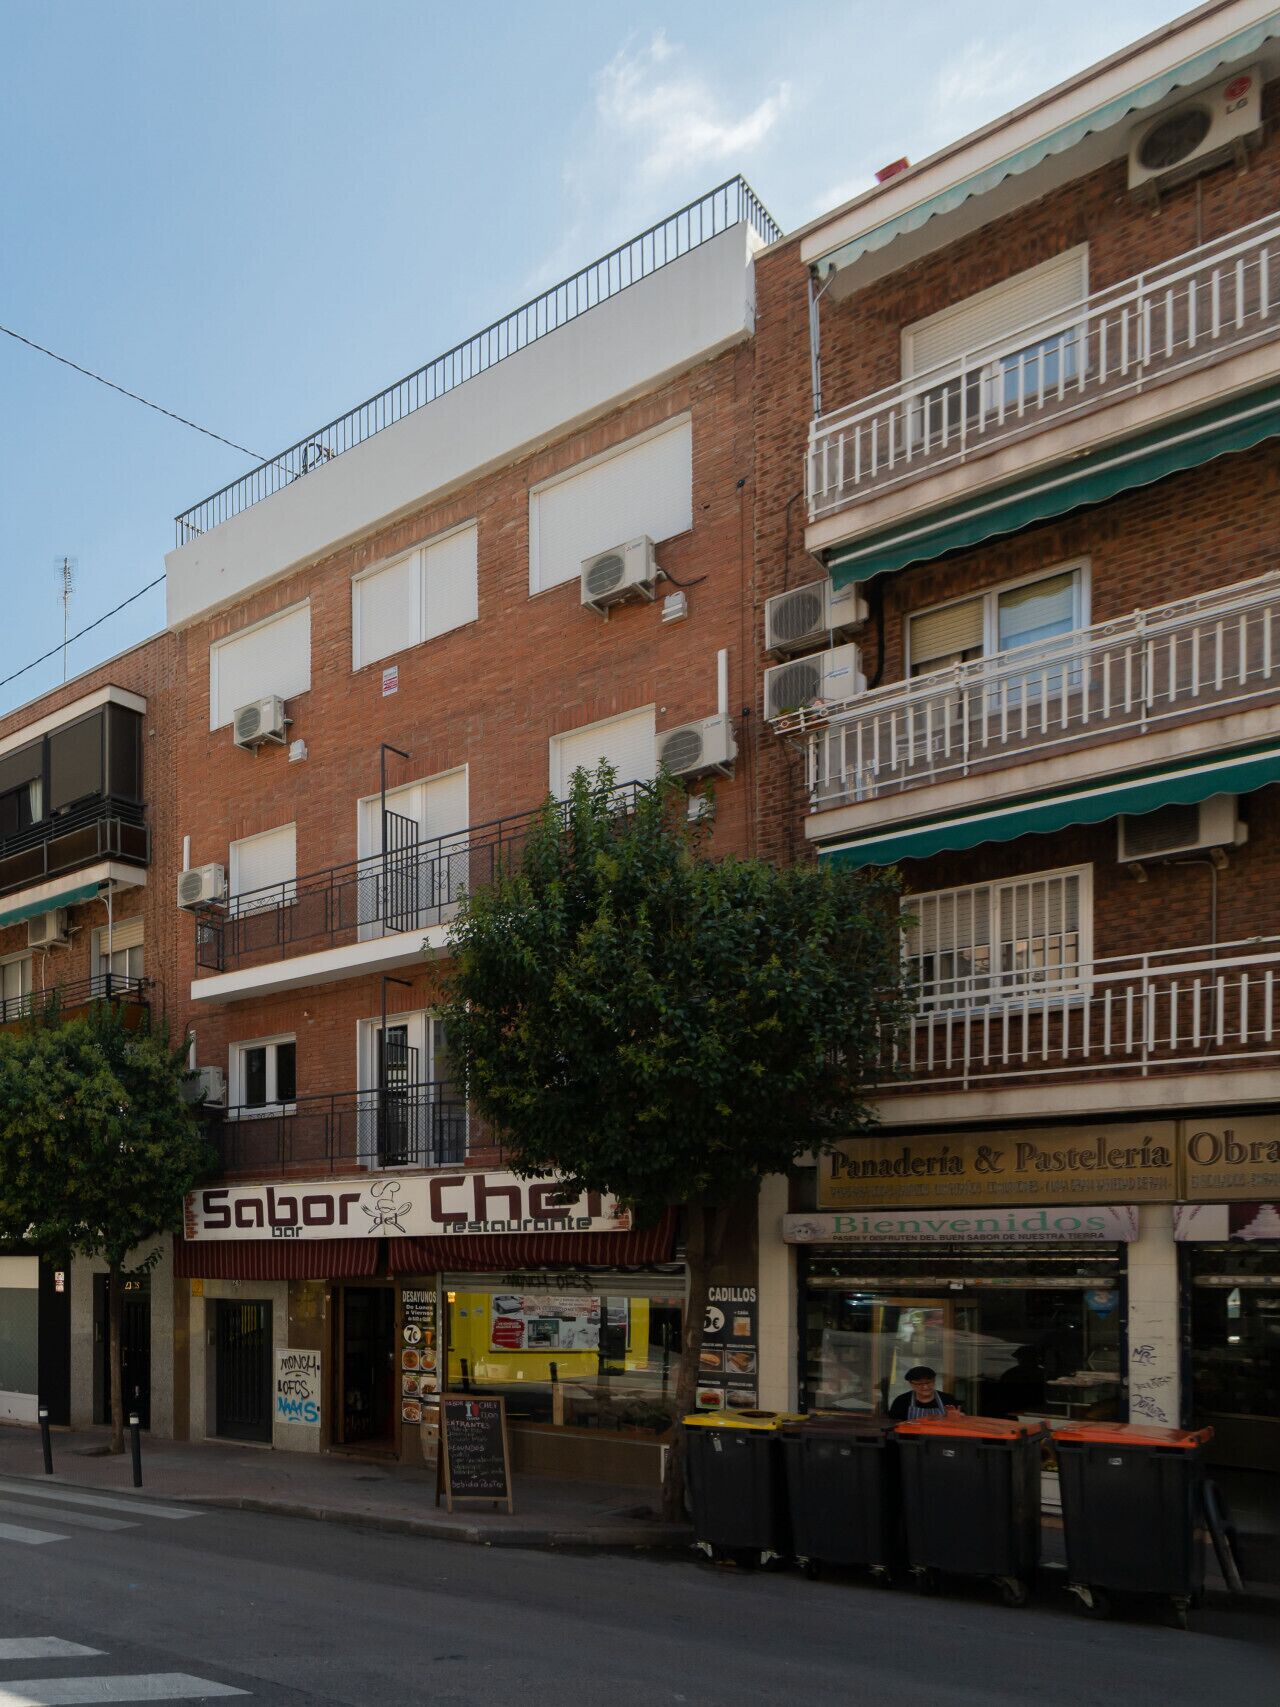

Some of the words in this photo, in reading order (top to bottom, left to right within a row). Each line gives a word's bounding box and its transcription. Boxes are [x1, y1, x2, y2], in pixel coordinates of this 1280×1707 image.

[1225, 98, 1248, 115] LG
[830, 1144, 965, 1180] Panadería
[972, 1145, 1005, 1173] &
[1014, 1136, 1172, 1172] Pastelería
[1188, 1129, 1280, 1165] Obra
[203, 1187, 361, 1229] Sabor
[374, 1212, 399, 1225] del
[272, 1226, 303, 1237] bar
[444, 1216, 593, 1233] restaurante
[833, 1211, 1106, 1234] Bienvenidos
[967, 1232, 1000, 1240] SABOR
[403, 1290, 437, 1303] DESAYUNOS
